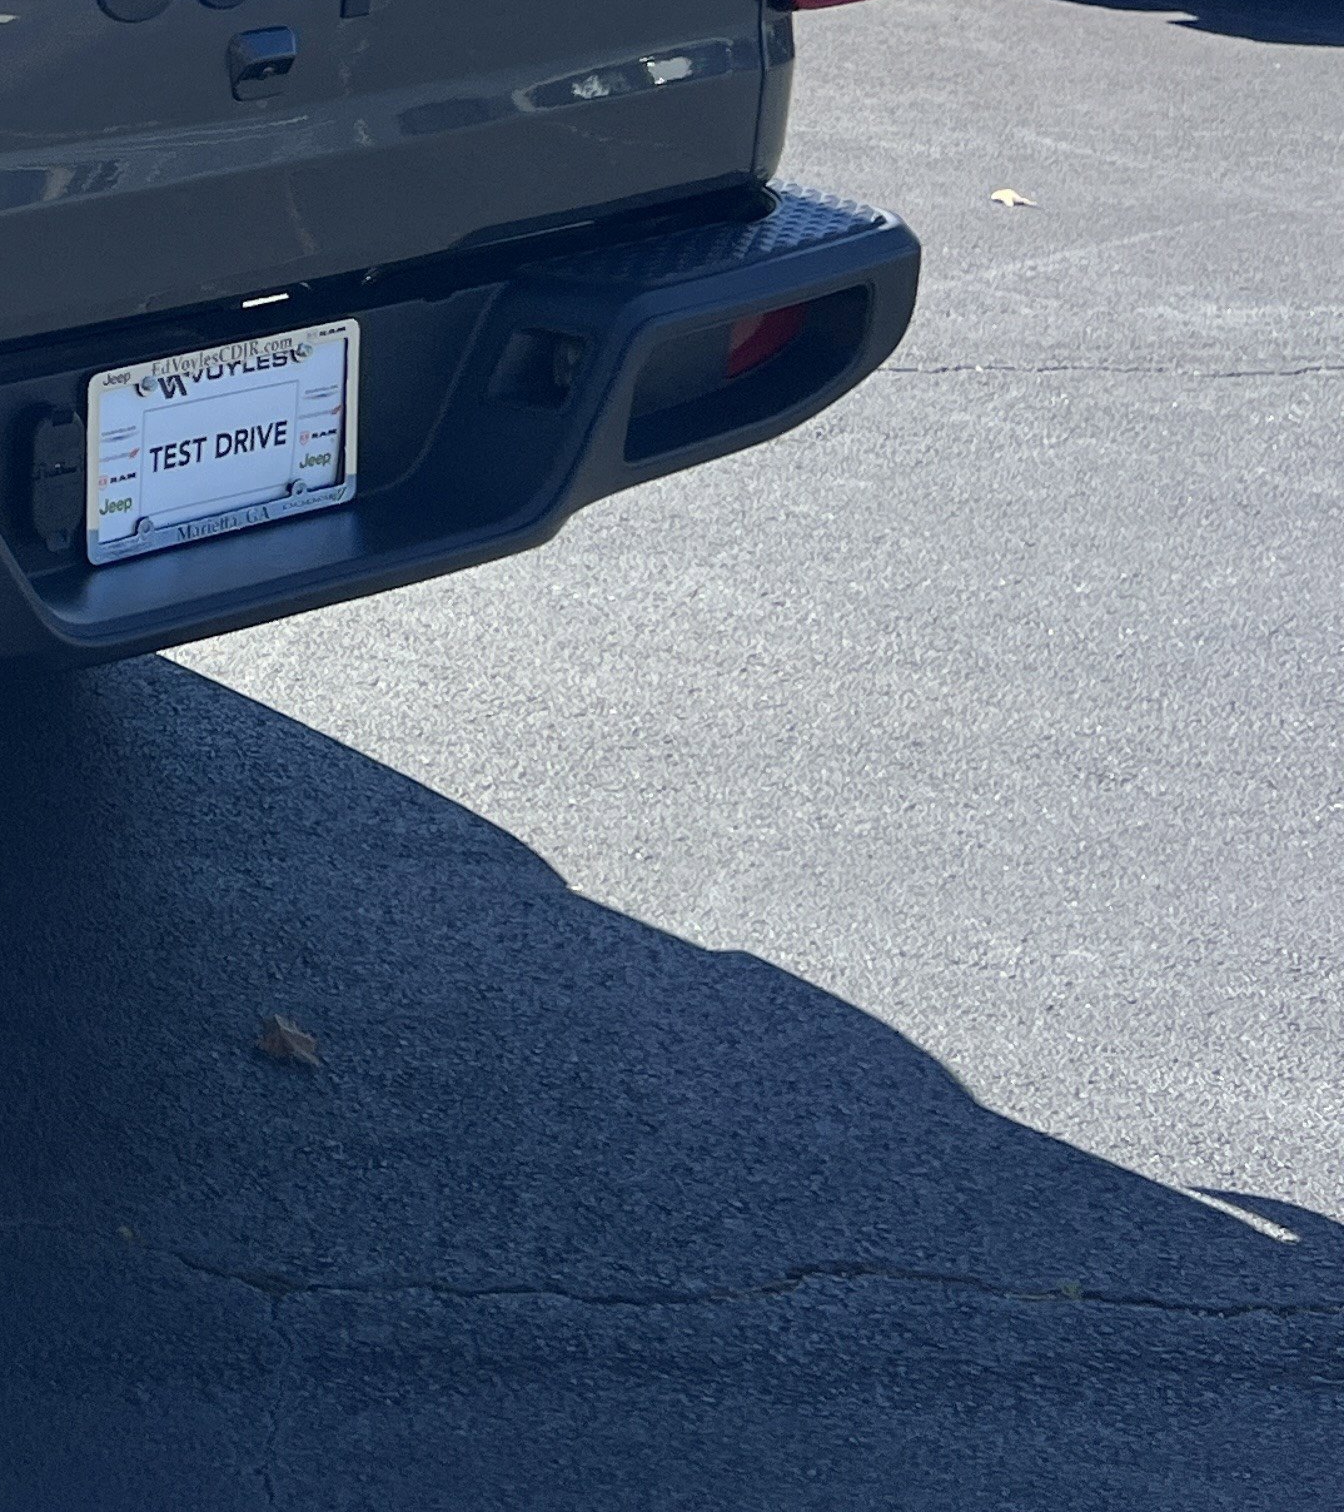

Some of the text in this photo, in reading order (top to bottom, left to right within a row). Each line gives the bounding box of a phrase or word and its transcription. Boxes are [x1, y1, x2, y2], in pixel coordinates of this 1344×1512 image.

[103, 372, 131, 387] Jeep
[149, 419, 288, 473] TEST DRIVE
[298, 452, 332, 469] Jeep
[99, 497, 133, 516] Jeep
[246, 506, 270, 524] GA
